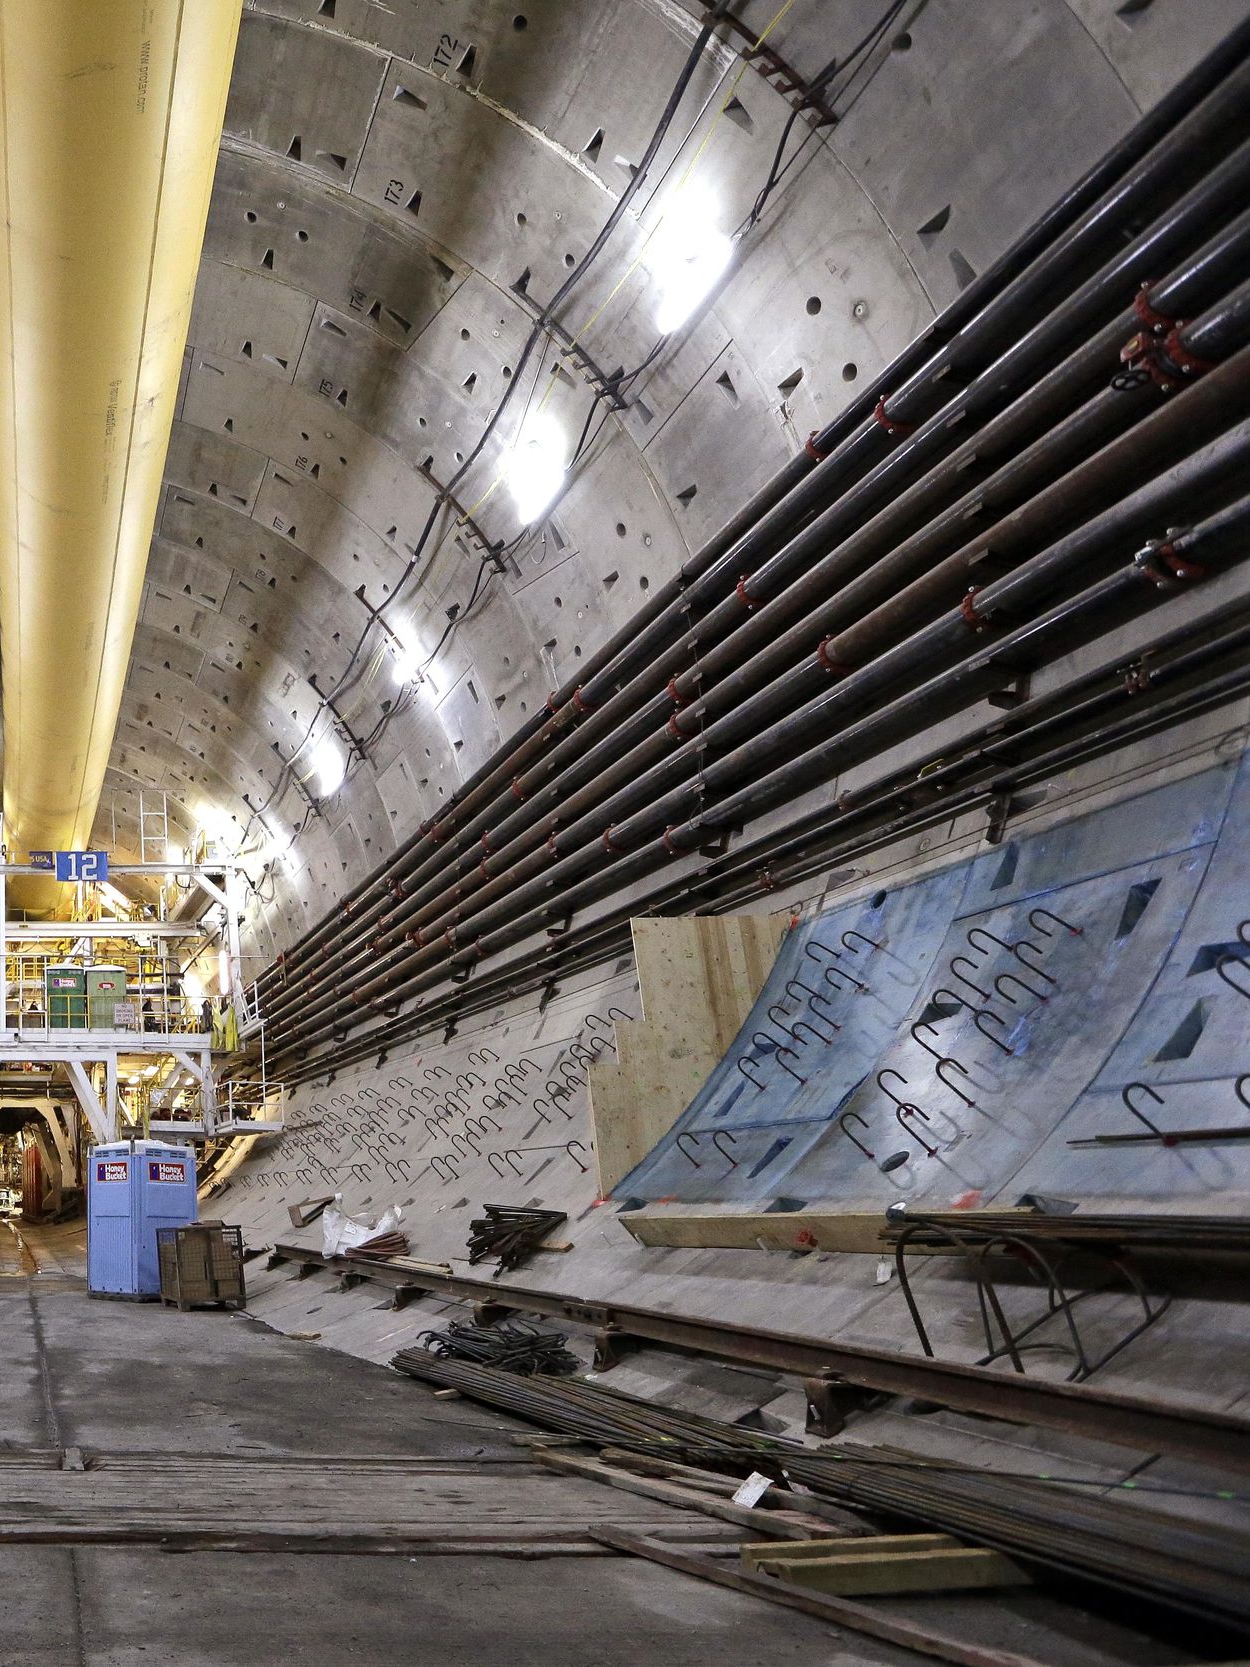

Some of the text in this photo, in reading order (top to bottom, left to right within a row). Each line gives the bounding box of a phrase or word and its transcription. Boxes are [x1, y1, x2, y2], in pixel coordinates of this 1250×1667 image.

[433, 34, 458, 67] 172
[384, 179, 404, 205] 173
[349, 289, 367, 312] 174
[318, 378, 333, 398] 175
[67, 853, 98, 880] 12
[105, 1164, 125, 1174] Honey
[105, 1172, 127, 1180] Bucket
[159, 1164, 181, 1175] Honey
[159, 1172, 184, 1181] Bucket
